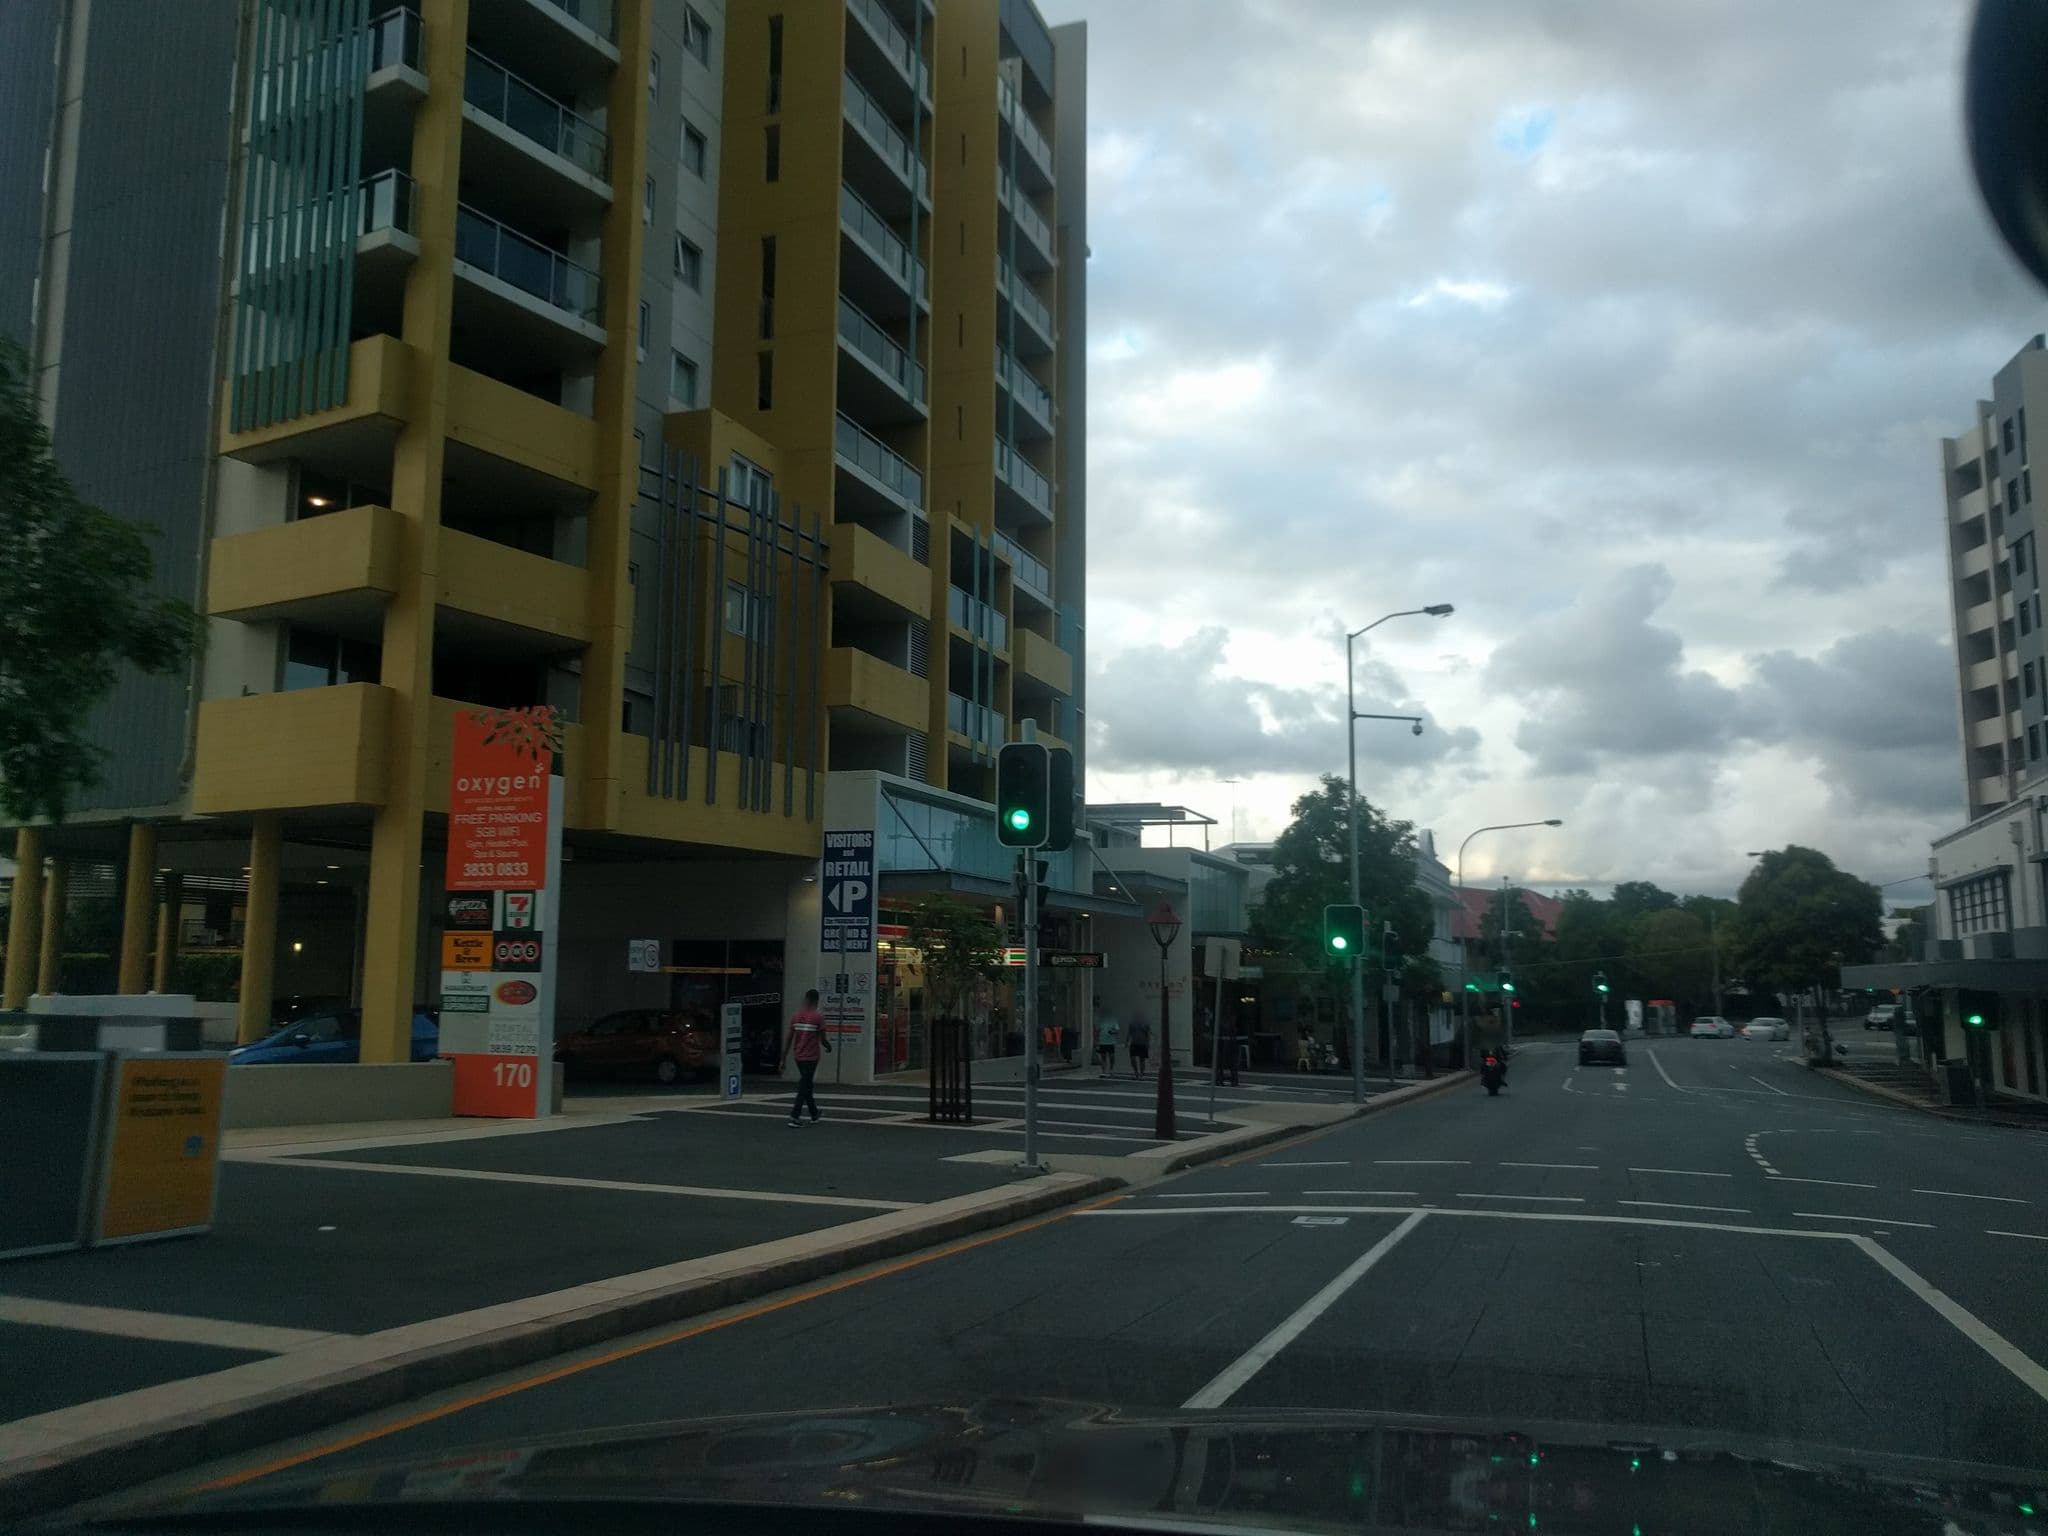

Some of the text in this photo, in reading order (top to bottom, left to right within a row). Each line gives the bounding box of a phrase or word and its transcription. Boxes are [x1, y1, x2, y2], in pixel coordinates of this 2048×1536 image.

[457, 775, 540, 795] oxygen
[455, 812, 542, 824] FREE PARKING
[826, 833, 872, 848] VISITORS
[463, 862, 528, 876] 3833 0833
[825, 861, 871, 877] RETAIL
[842, 880, 868, 913] P
[824, 928, 859, 938] GROND
[824, 939, 868, 949] BASMENT
[493, 1063, 531, 1088] 170
